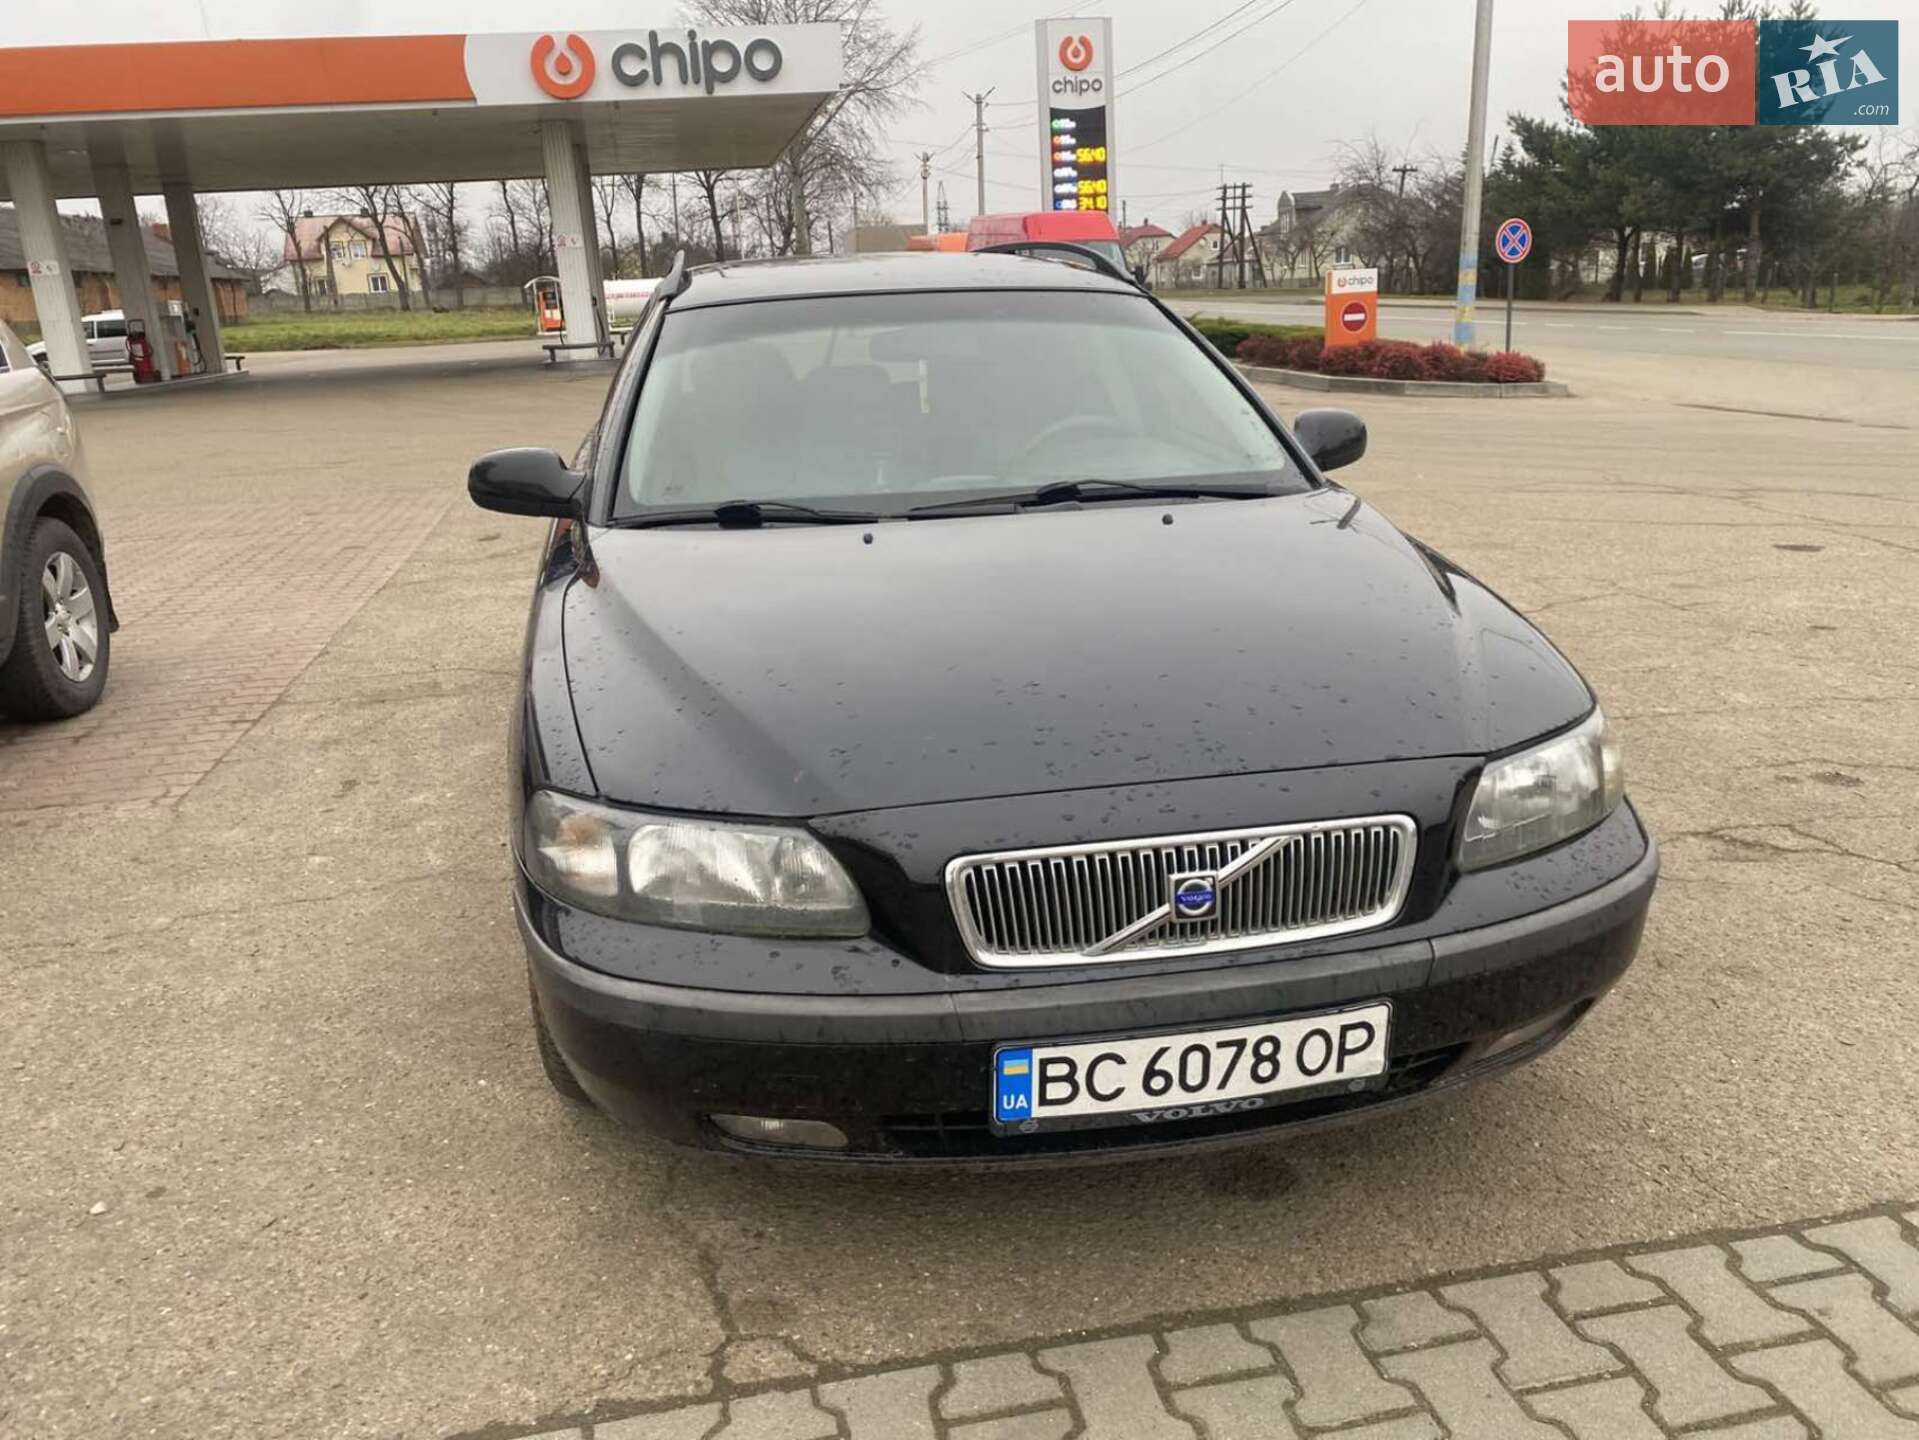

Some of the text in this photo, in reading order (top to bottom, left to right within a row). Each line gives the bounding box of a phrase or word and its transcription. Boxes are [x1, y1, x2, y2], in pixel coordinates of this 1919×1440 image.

[611, 29, 783, 95] chipo
[1051, 75, 1103, 97] chipo
[1038, 1020, 1375, 1107] BC 6078 OP
[1003, 1094, 1029, 1110] UA
[1131, 1098, 1264, 1123] VOLVO
